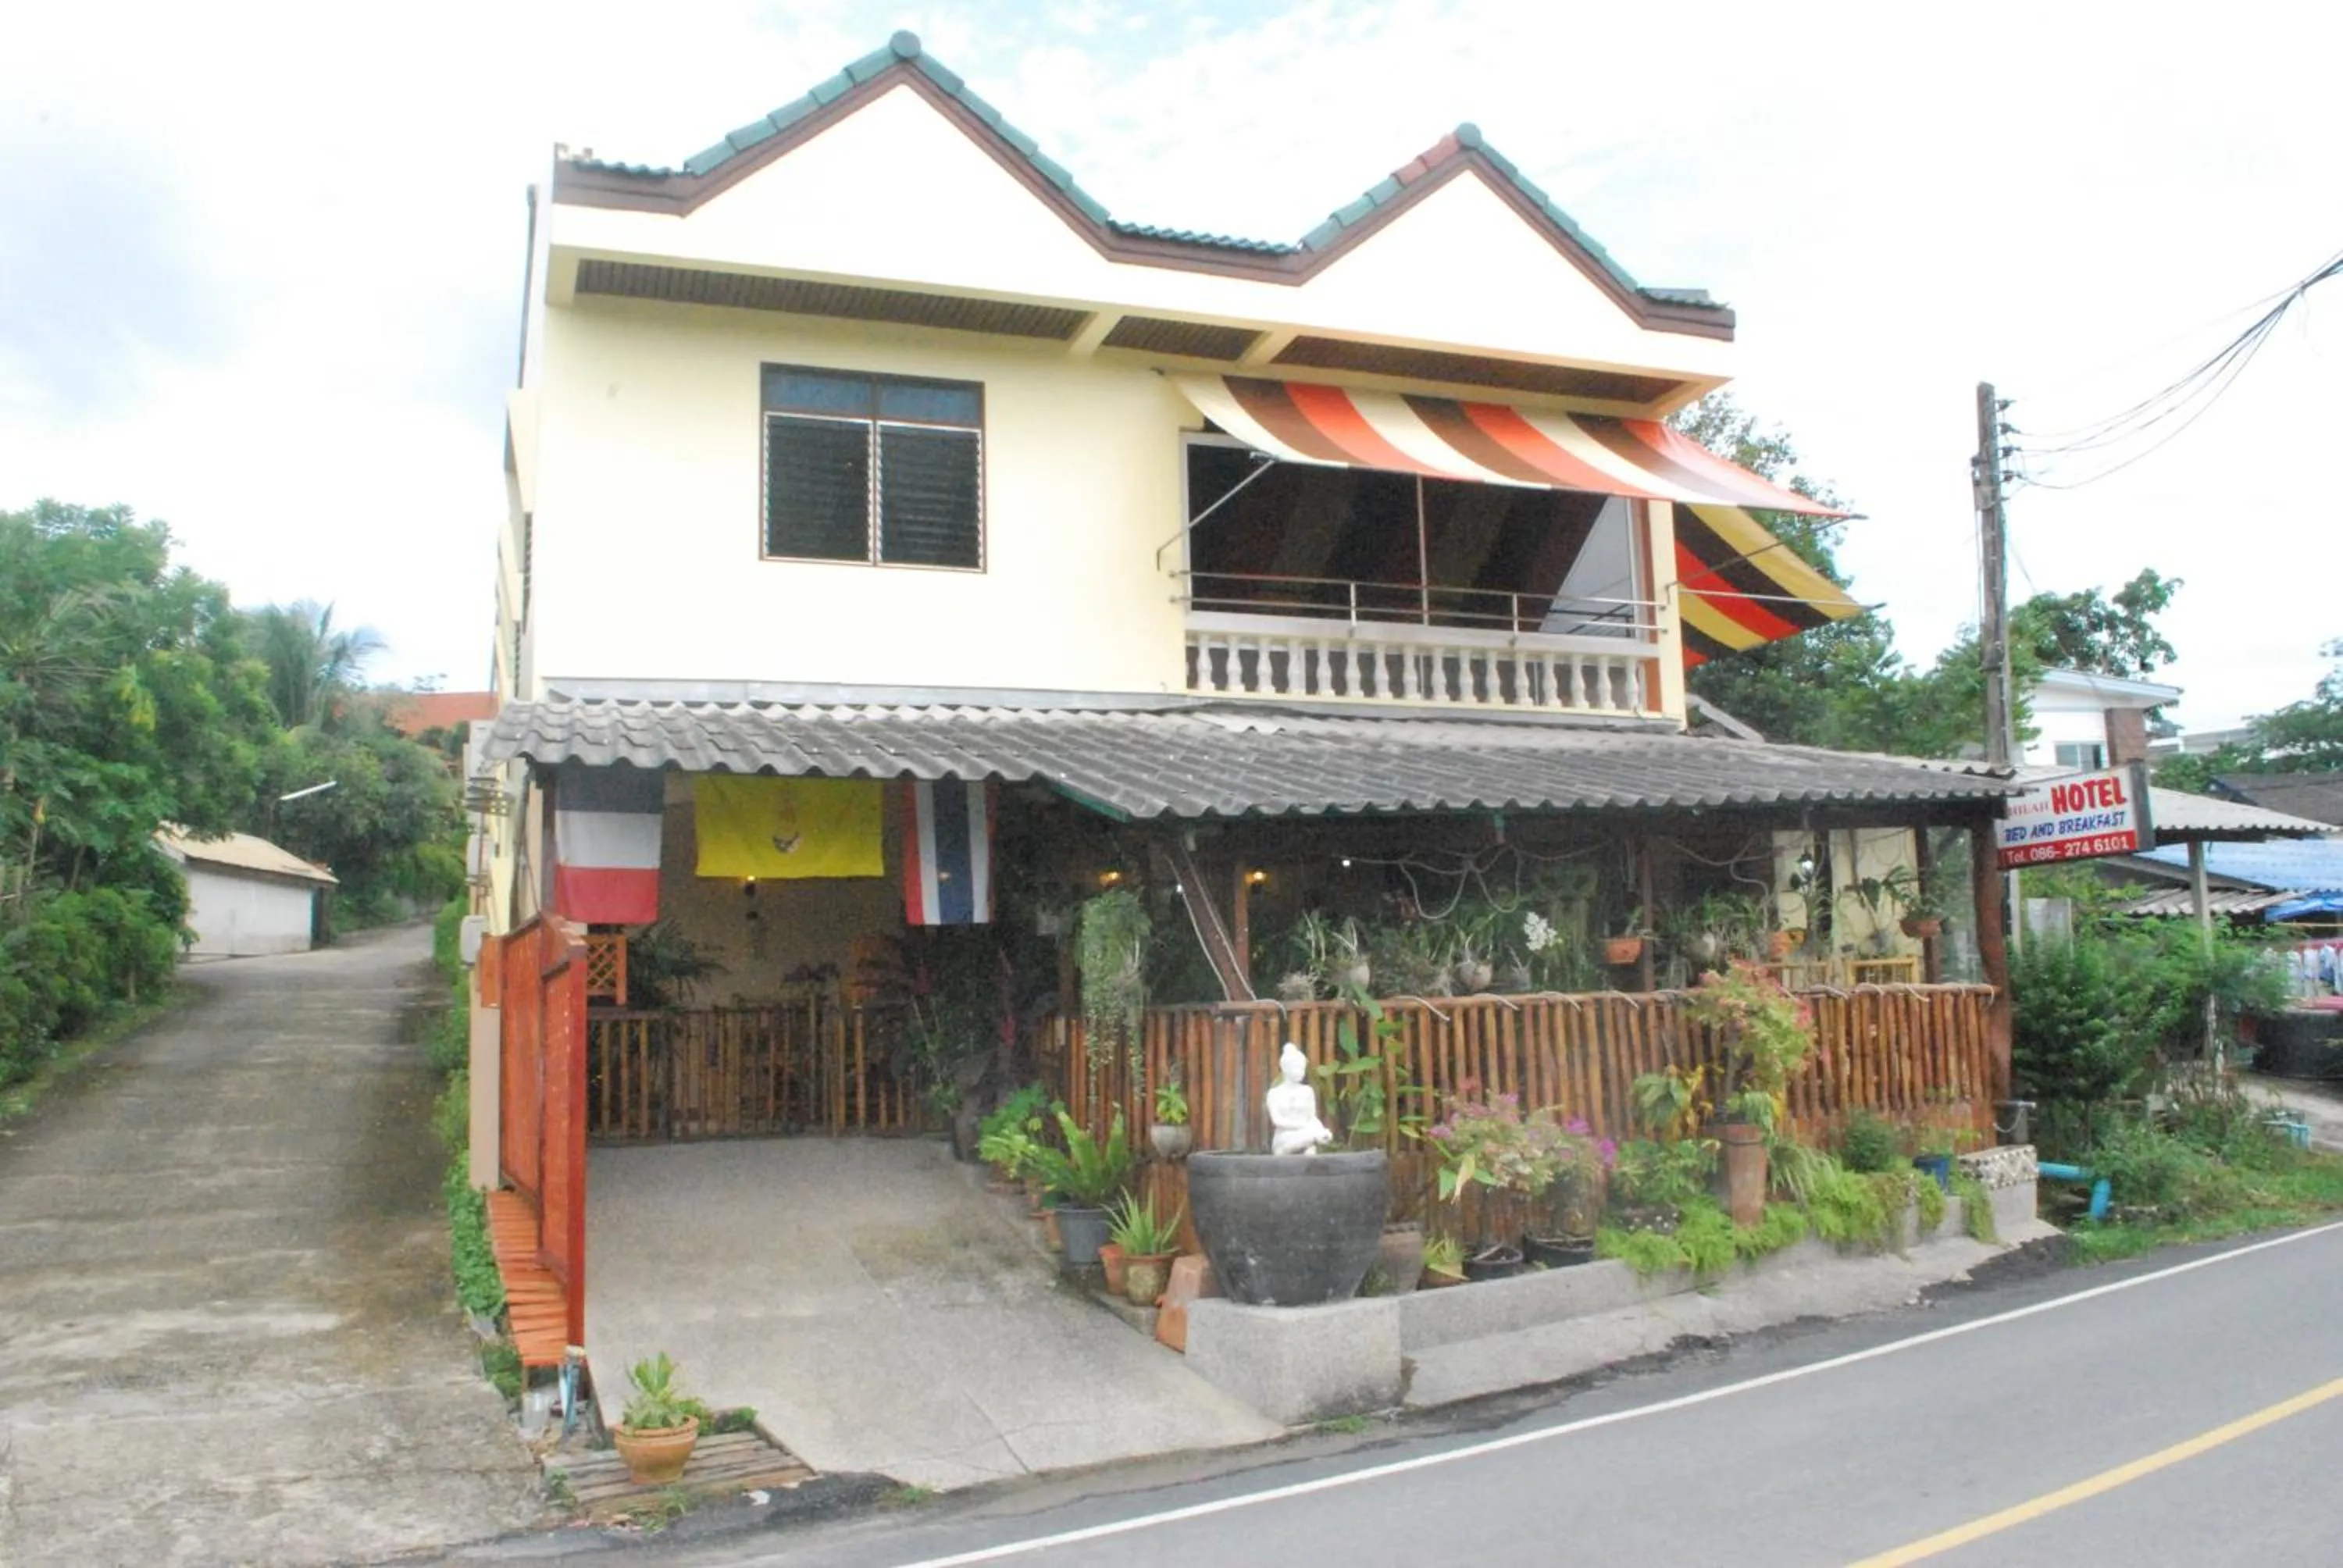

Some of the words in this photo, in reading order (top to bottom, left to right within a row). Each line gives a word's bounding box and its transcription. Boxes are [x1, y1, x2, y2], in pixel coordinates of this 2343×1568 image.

[2051, 776, 2127, 814] HOTEL
[2005, 826, 2027, 842] BED
[2031, 822, 2054, 838] AND
[2059, 811, 2125, 835] BREAKFAST
[2064, 841, 2092, 857] 274
[2095, 836, 2129, 853] 6101
